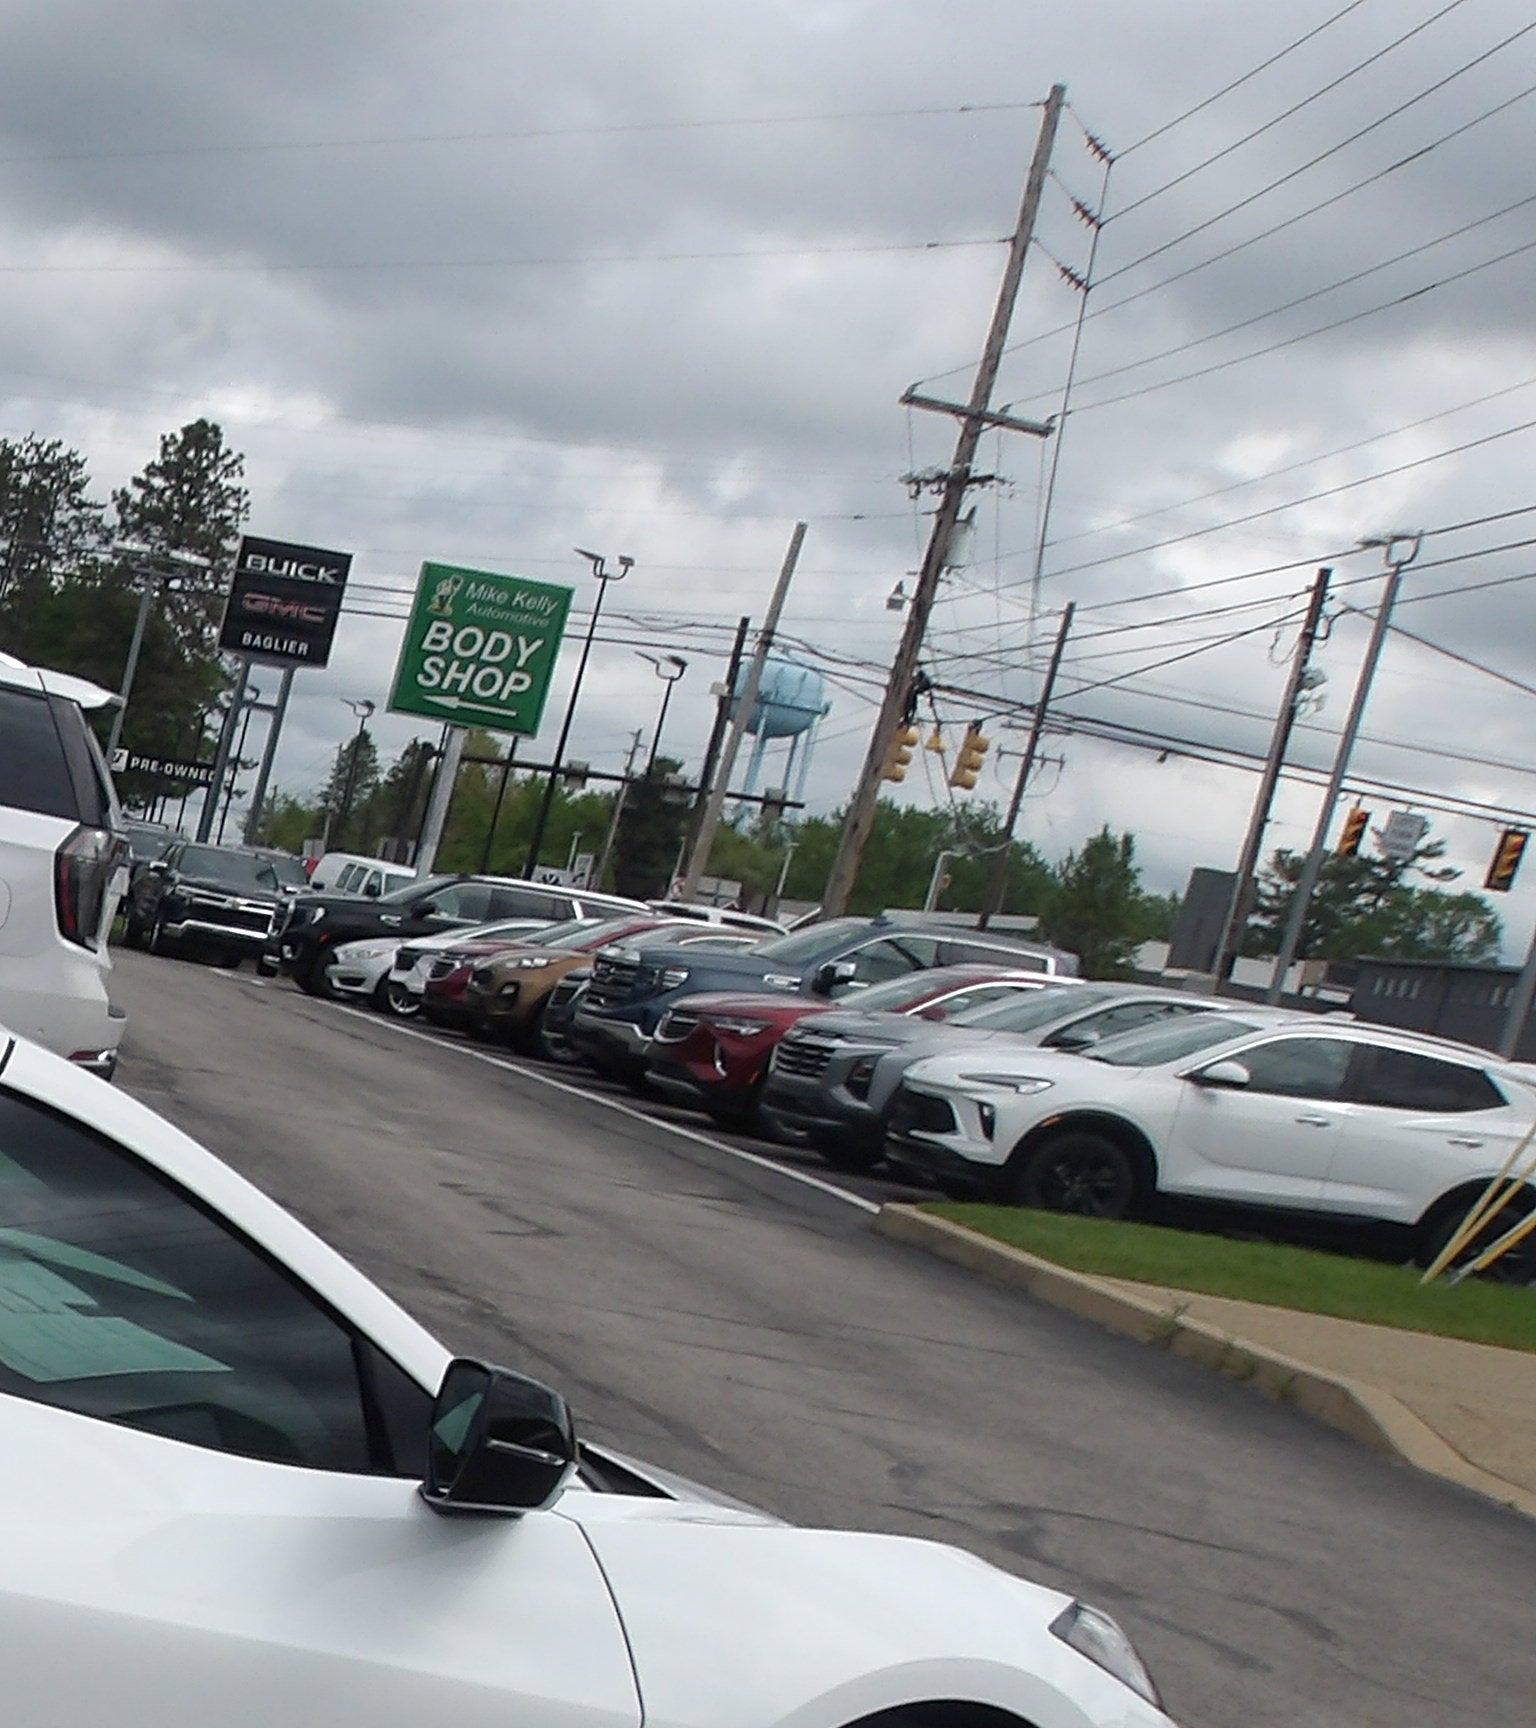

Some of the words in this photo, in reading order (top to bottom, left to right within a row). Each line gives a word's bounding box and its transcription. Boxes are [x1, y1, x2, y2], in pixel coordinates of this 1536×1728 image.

[246, 553, 340, 585] BUICK
[242, 592, 327, 622] GMC
[465, 581, 510, 605] Mike
[511, 590, 559, 616] Kelly
[465, 602, 550, 628] Automotive
[241, 631, 309, 656] BAGLIER
[421, 619, 545, 668] BODY
[416, 655, 532, 701] SHOP
